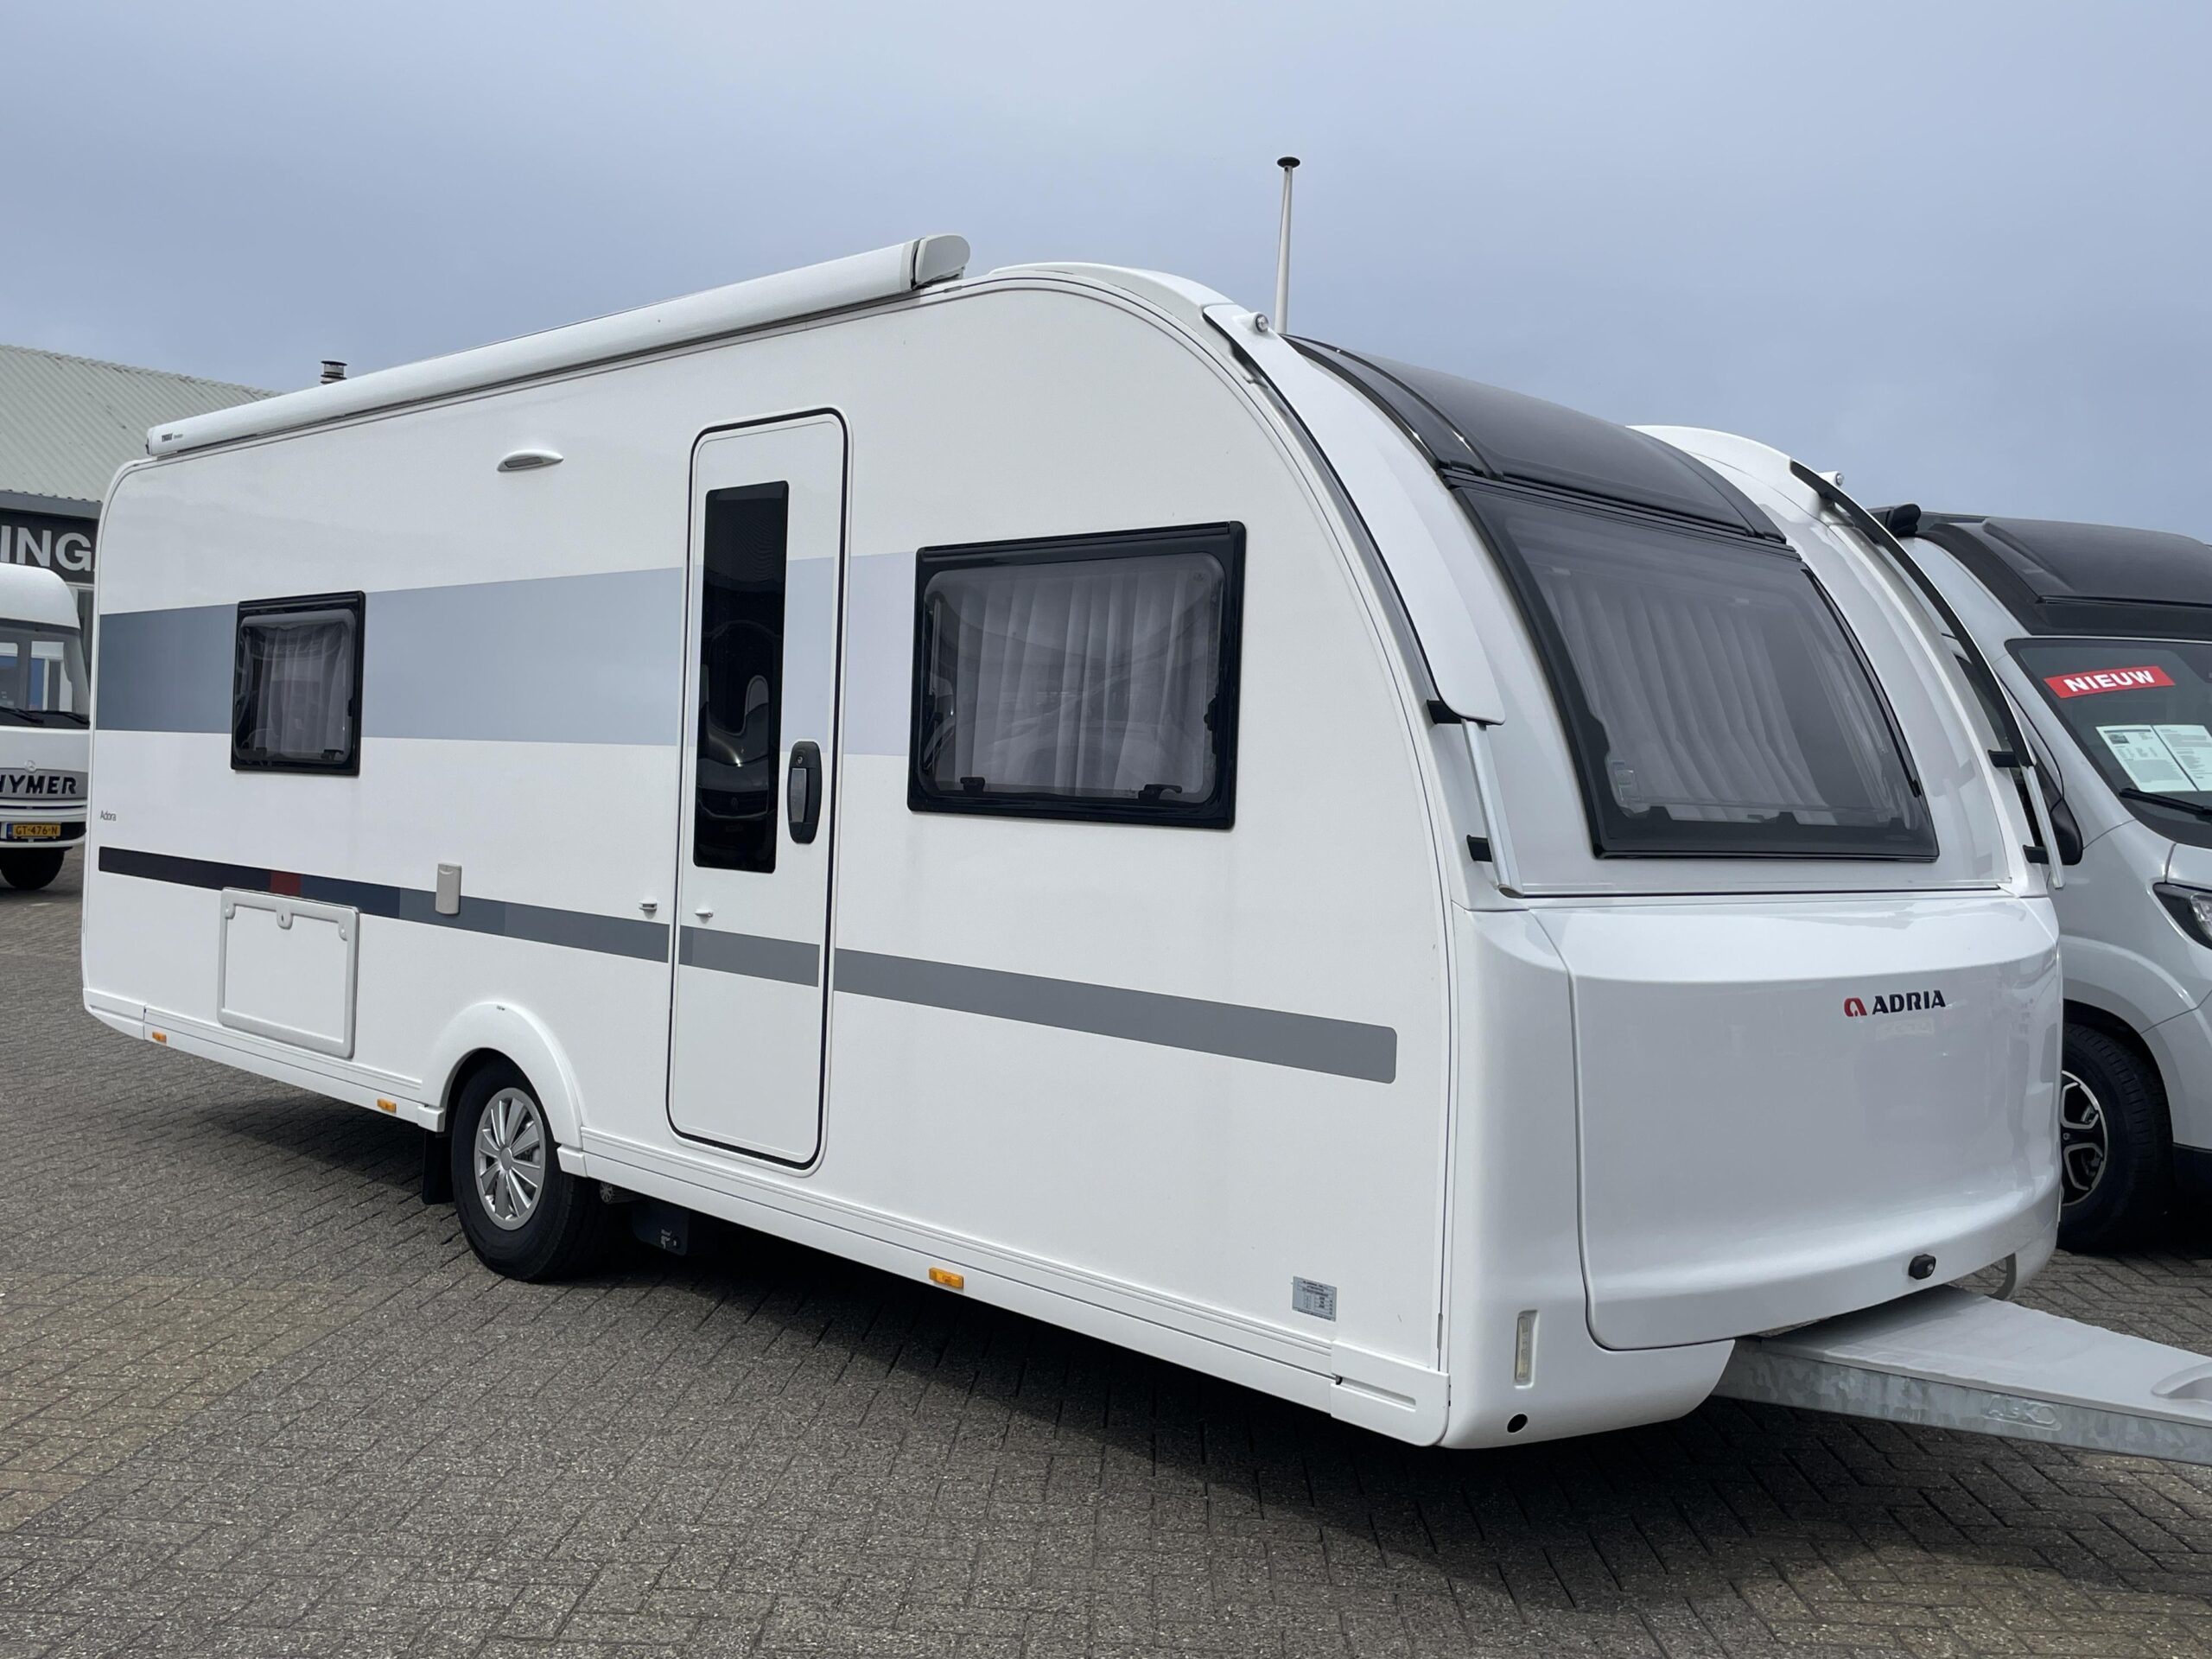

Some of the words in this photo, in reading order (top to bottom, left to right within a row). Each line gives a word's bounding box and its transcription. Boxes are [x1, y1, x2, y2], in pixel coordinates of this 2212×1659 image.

[2063, 671, 2155, 692] NIEUW
[99, 810, 117, 822] Adora
[16, 825, 58, 836] GT-476-N
[1872, 989, 1946, 1015] ADRIA
